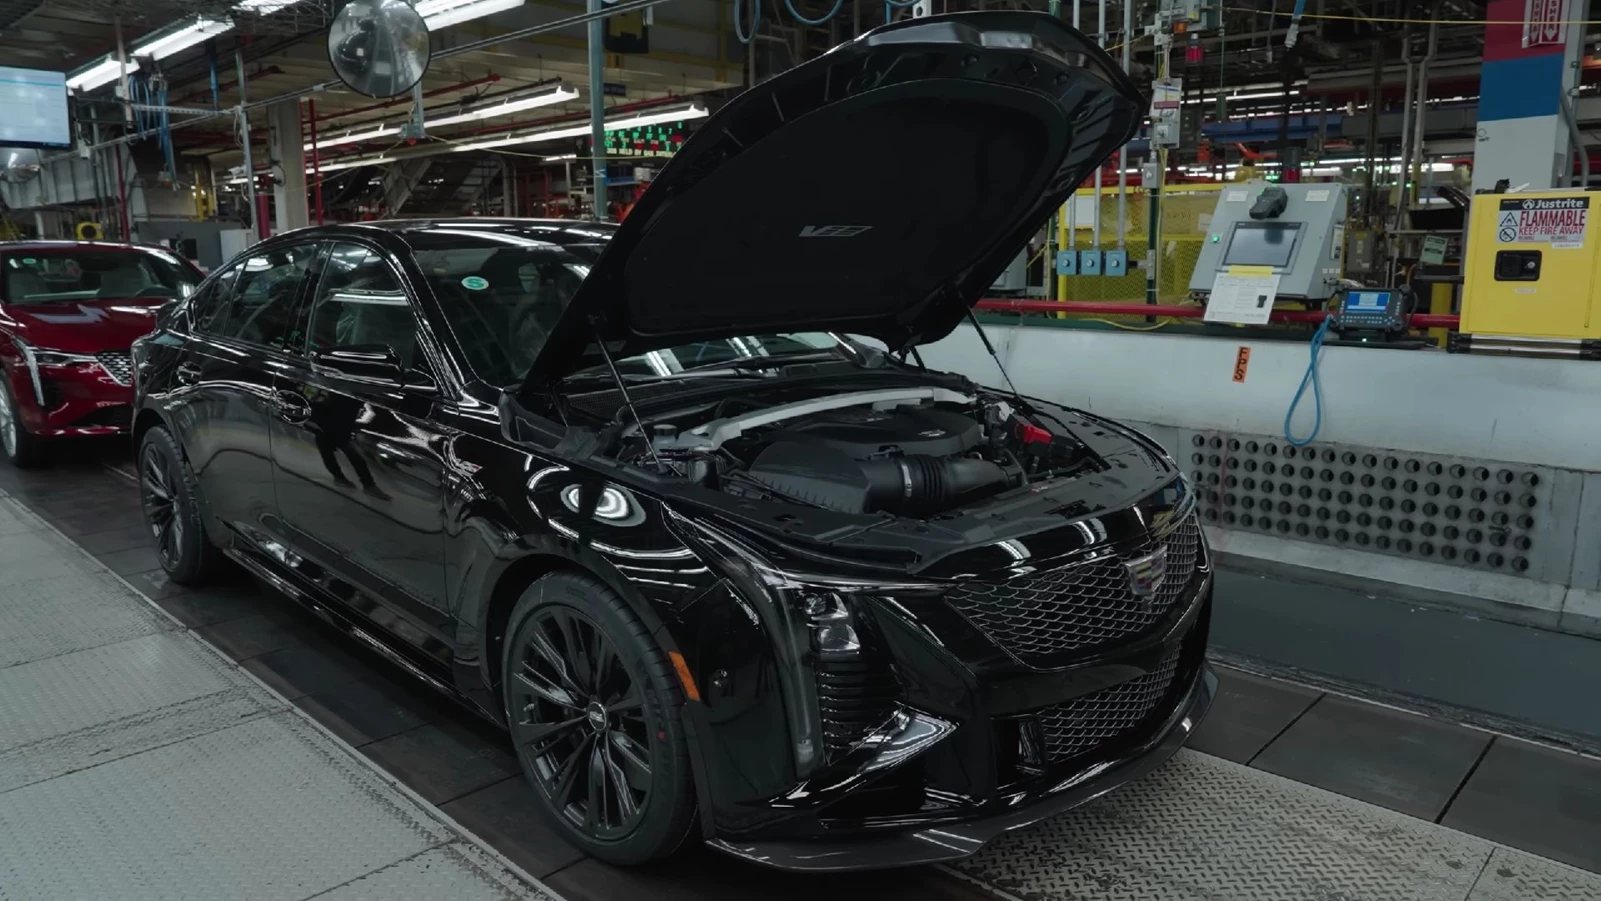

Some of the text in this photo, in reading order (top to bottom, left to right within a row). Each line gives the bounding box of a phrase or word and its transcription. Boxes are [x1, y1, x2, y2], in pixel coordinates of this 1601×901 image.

[1535, 198, 1584, 209] Justrite
[1520, 210, 1586, 227] FLAMMABLE
[1518, 226, 1584, 236] KEEP FIRE AWAY
[1234, 347, 1248, 381] FPS
